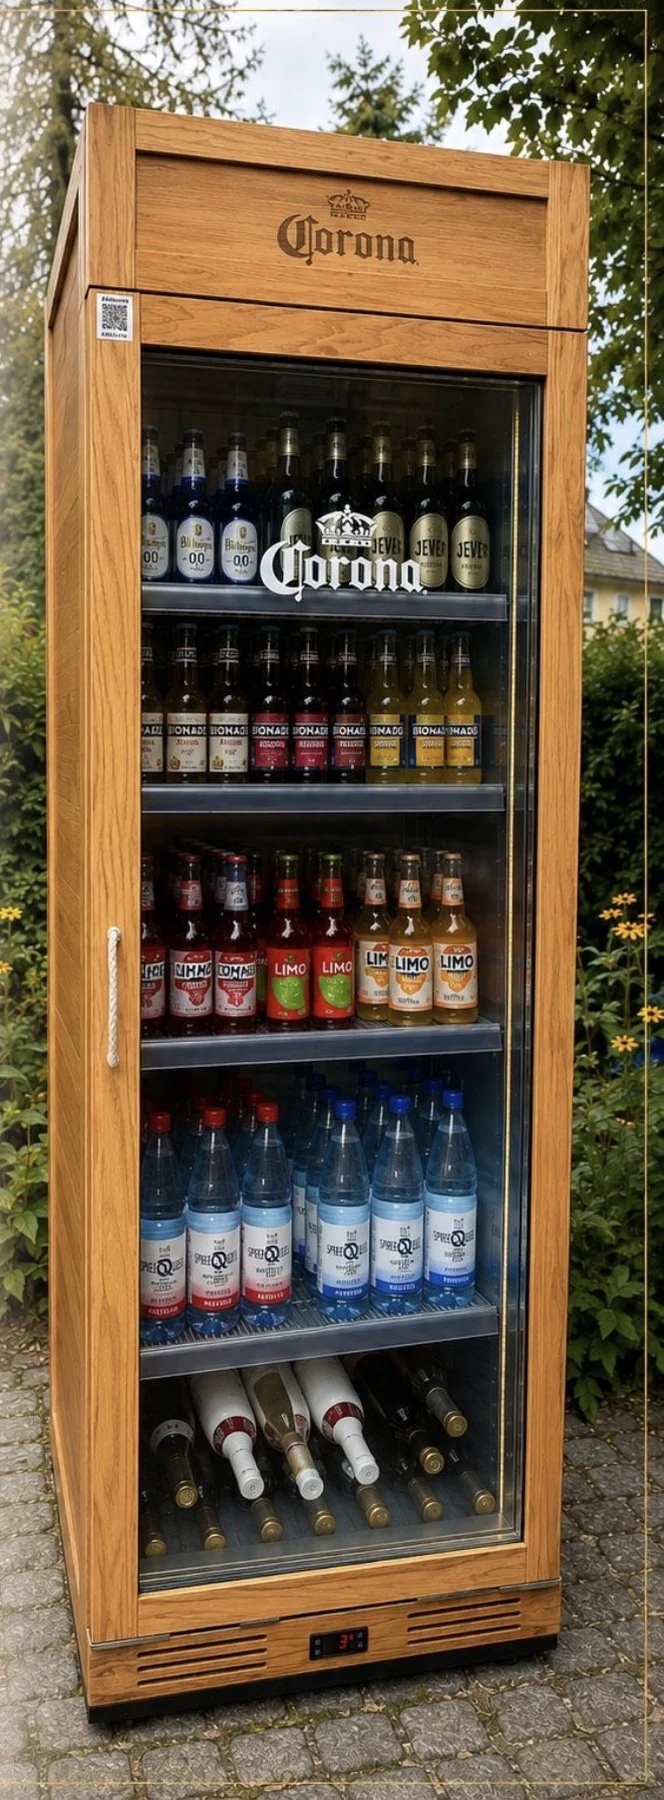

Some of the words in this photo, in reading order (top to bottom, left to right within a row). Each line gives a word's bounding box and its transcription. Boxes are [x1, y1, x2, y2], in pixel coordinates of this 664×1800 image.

[366, 951, 389, 966] LIM
[396, 956, 430, 971] LIMO
[440, 954, 474, 969] LIMO
[275, 962, 307, 976] LIMO
[322, 960, 353, 975] LIMO
